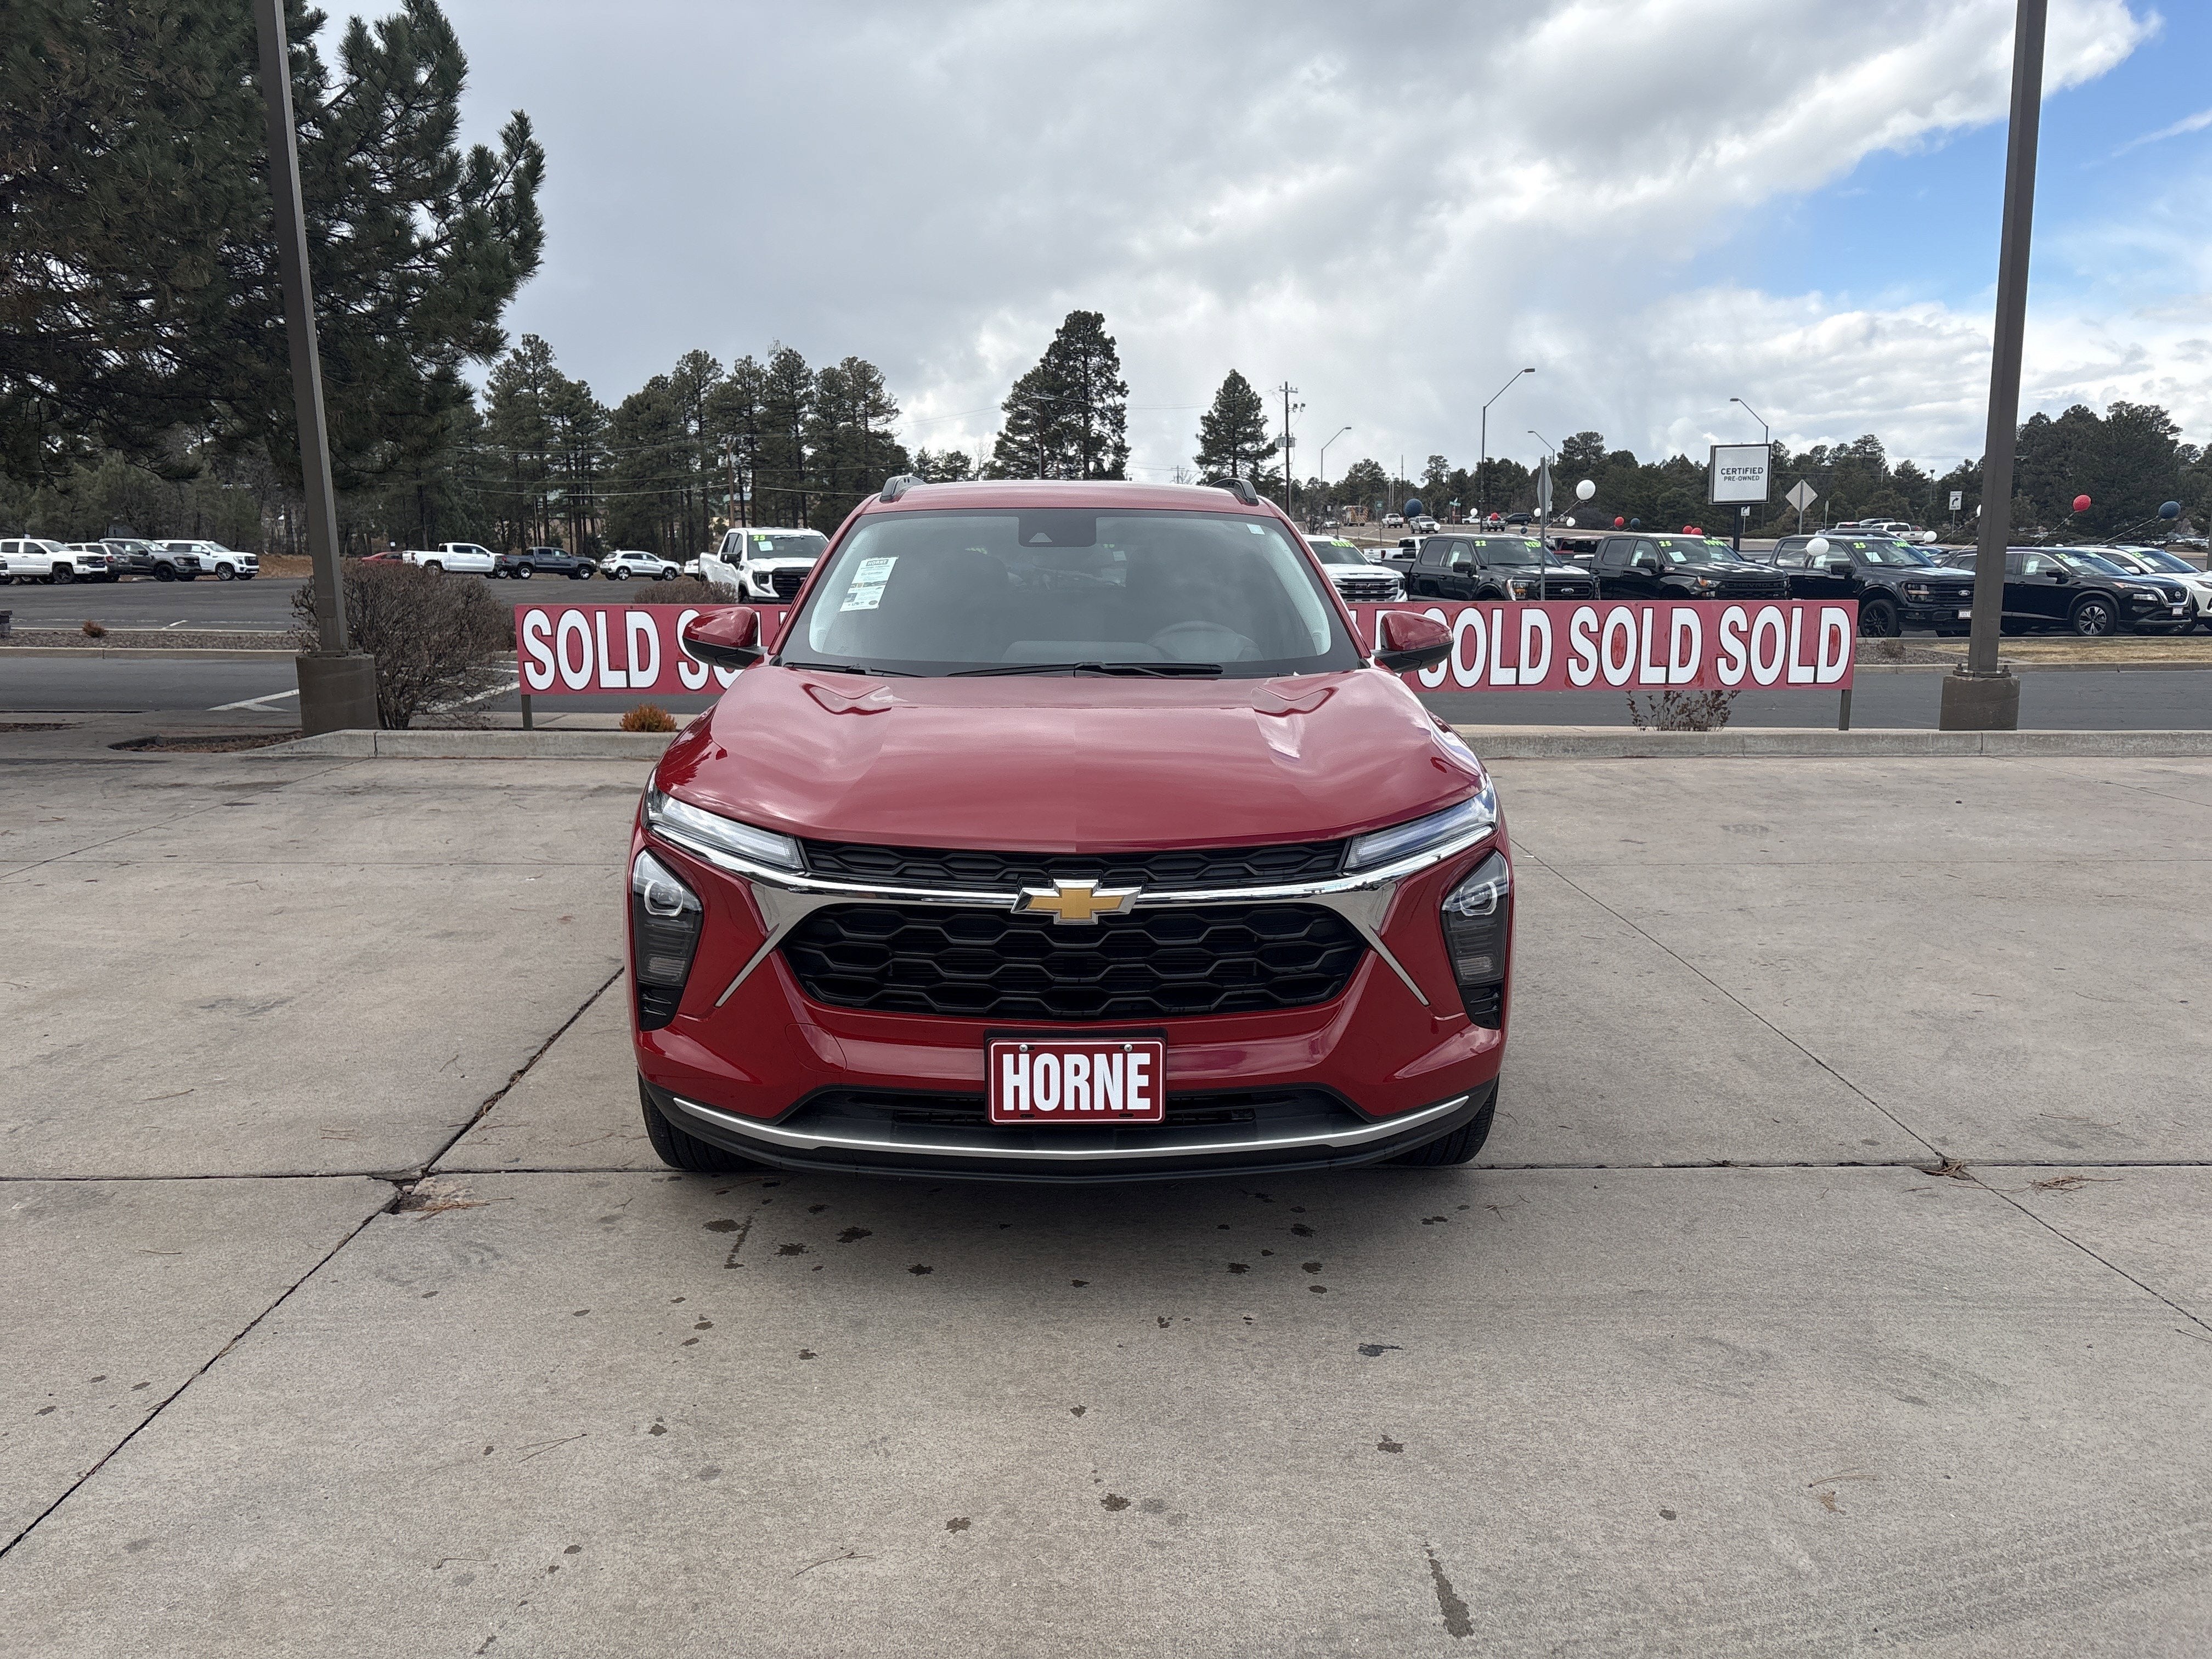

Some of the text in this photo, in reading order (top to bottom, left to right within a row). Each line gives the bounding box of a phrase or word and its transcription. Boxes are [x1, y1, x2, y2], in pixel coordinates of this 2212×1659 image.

[1720, 467, 1764, 475] CERTIFIED
[522, 608, 661, 691] SOLD
[1567, 605, 1703, 687] SOLD
[1716, 605, 1852, 687] SOLD
[1002, 1052, 1151, 1111] HORNE
